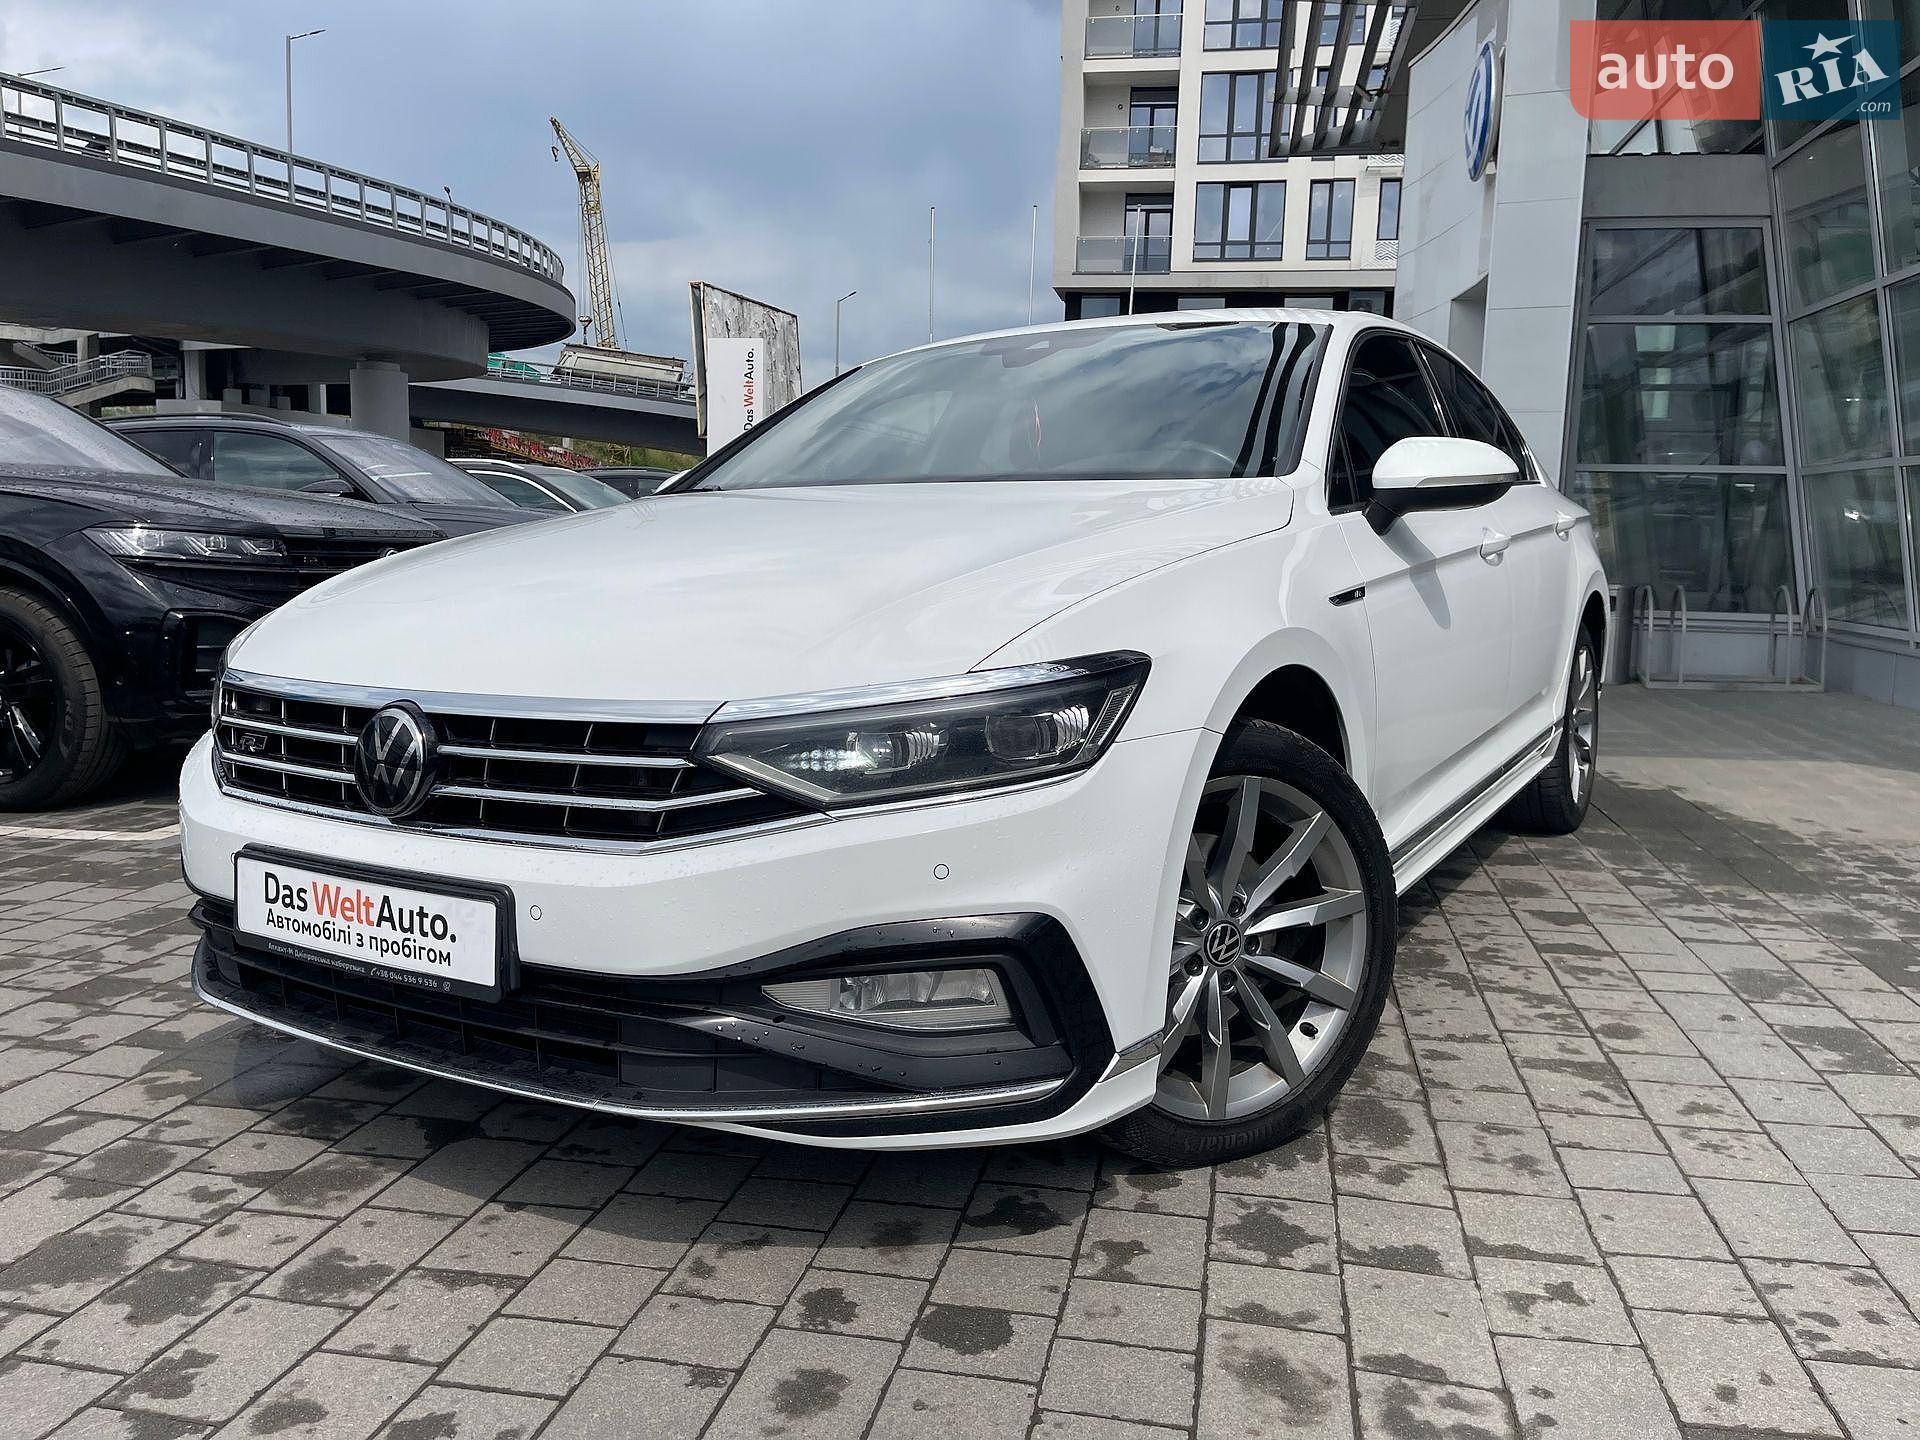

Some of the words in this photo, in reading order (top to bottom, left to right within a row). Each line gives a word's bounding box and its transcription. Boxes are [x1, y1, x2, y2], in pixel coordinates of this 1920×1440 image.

[743, 409, 754, 431] Das
[264, 871, 308, 912] Das
[266, 908, 351, 944] Автомобілі
[355, 932, 364, 948] з
[369, 935, 451, 966] пробігом
